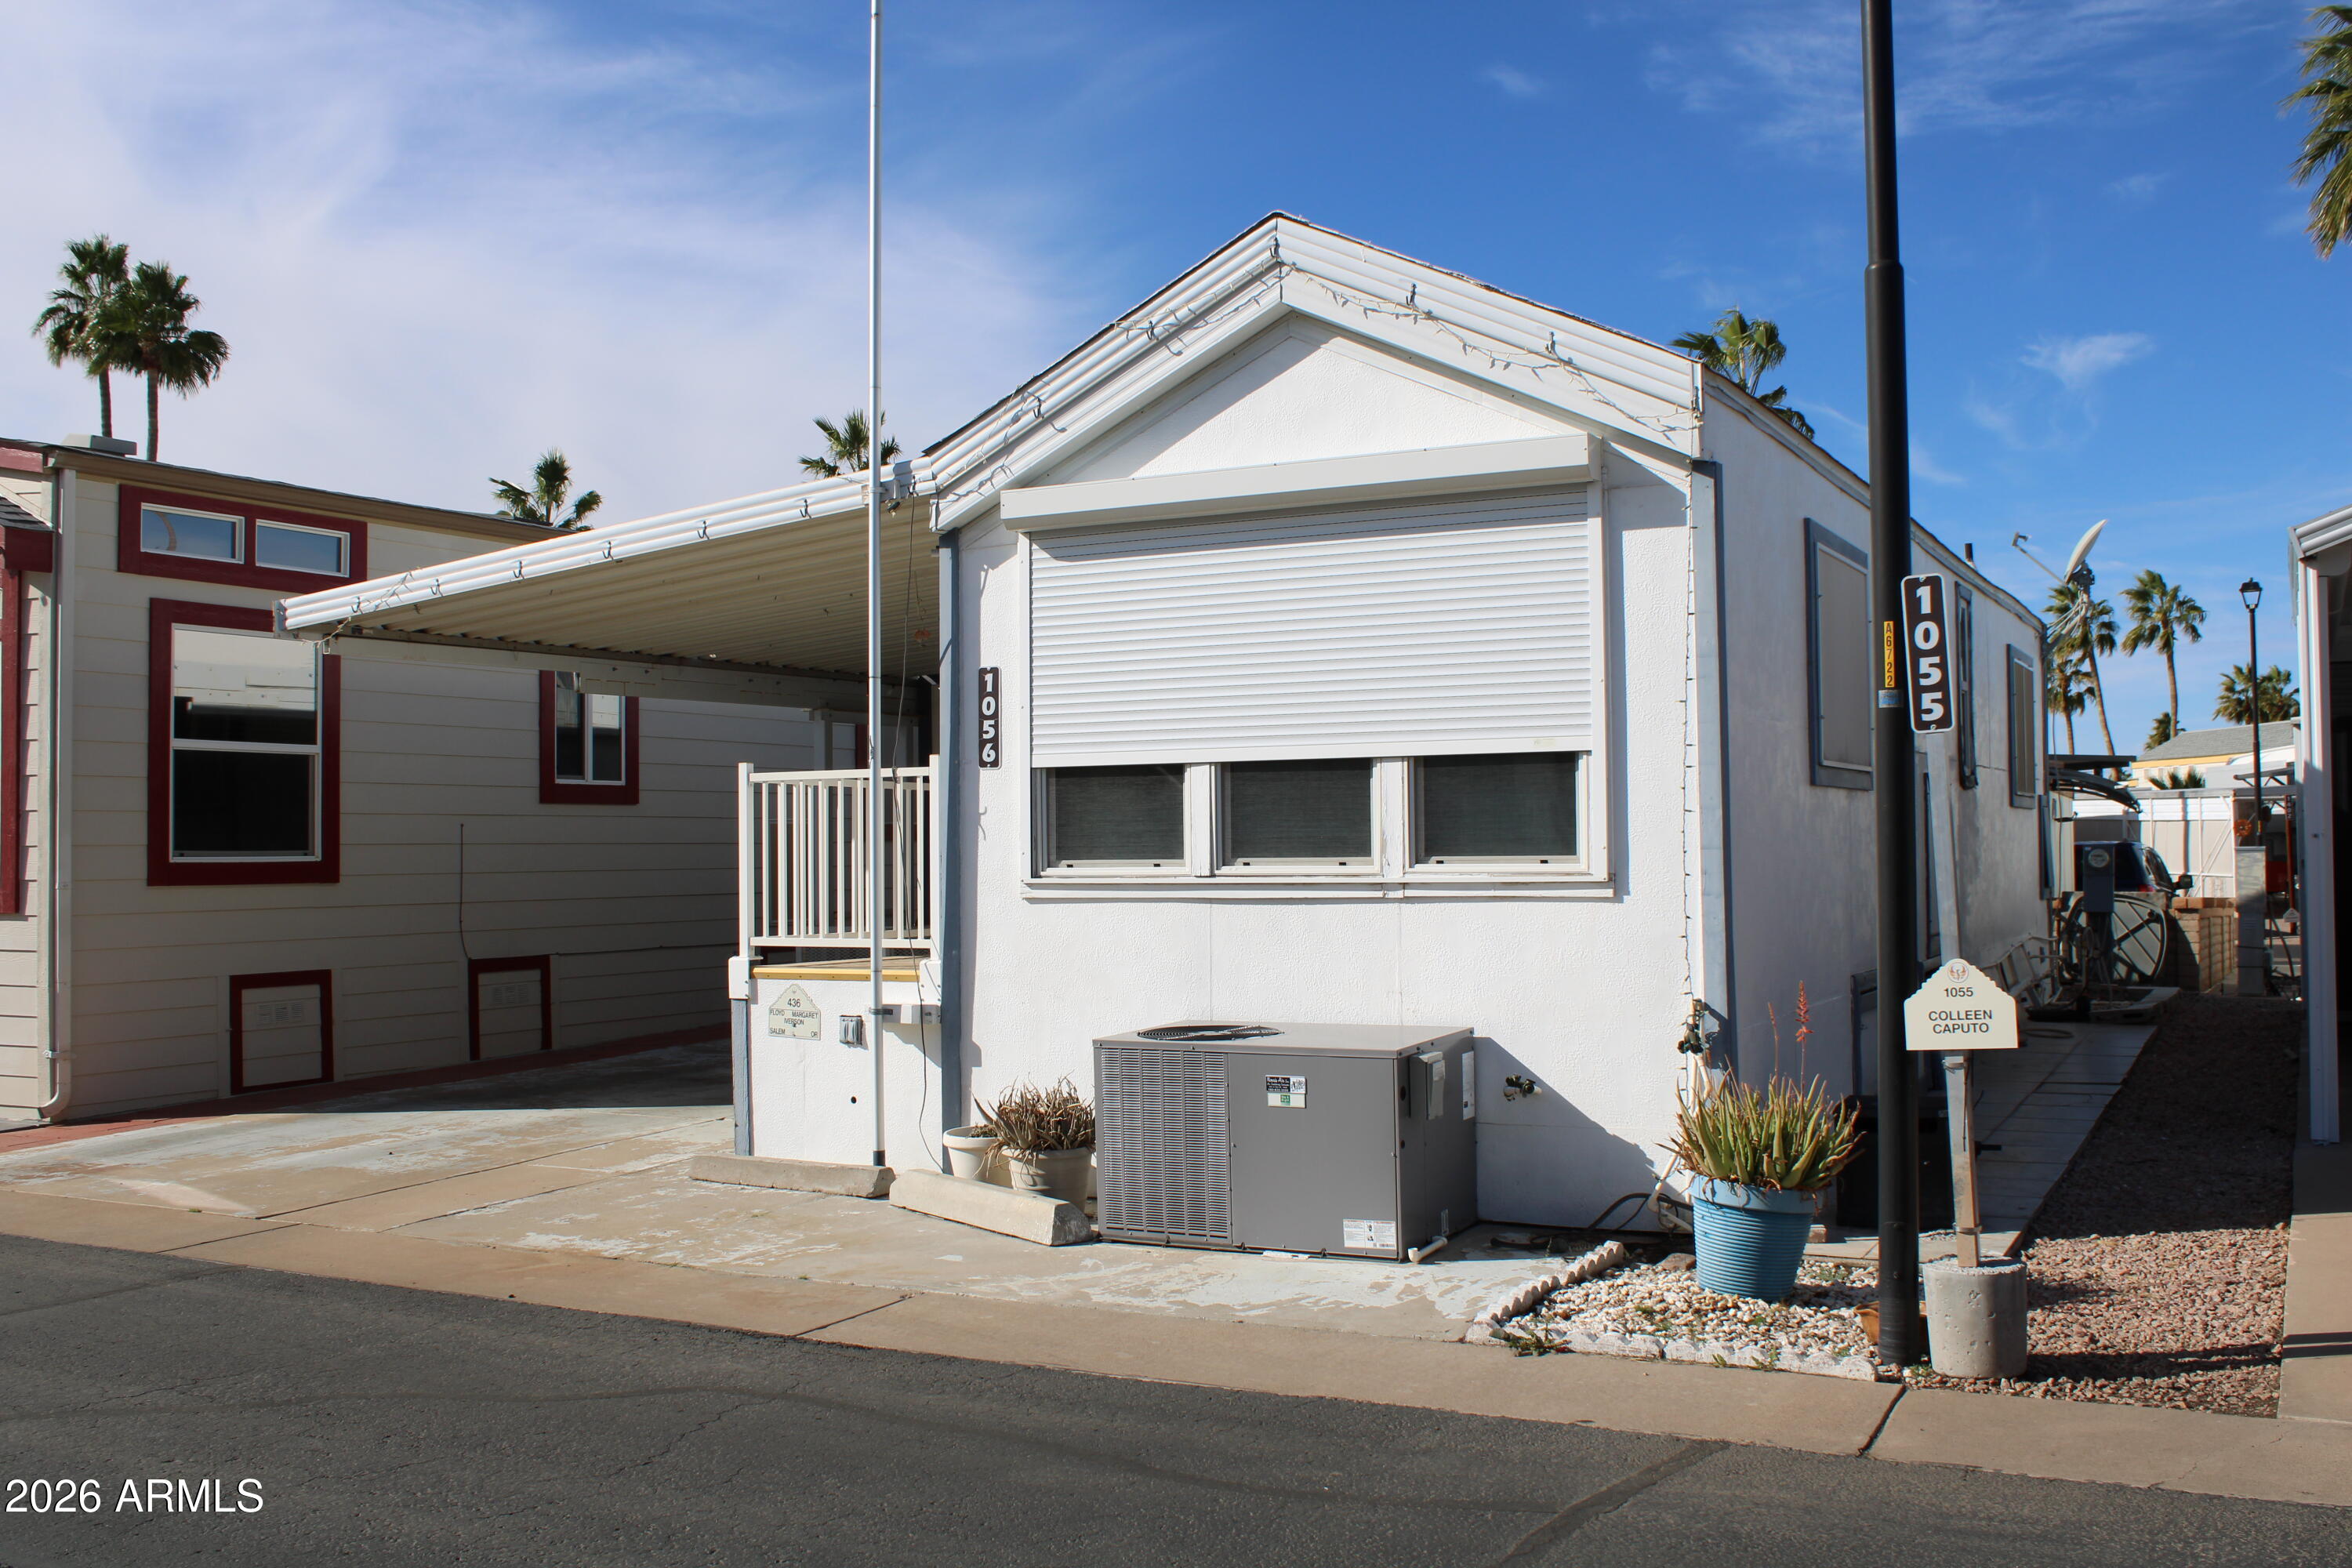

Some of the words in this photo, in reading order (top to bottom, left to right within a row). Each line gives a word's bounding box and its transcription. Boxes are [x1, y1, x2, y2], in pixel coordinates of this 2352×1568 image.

[1914, 585, 1944, 721] 1055
[982, 673, 996, 763] 1056
[1944, 986, 1974, 998] 1055
[787, 997, 801, 1008] 436
[792, 1011, 818, 1019] MARGARET
[1928, 1009, 1993, 1022] COLLEEN
[1933, 1022, 1989, 1034] CAPUTO
